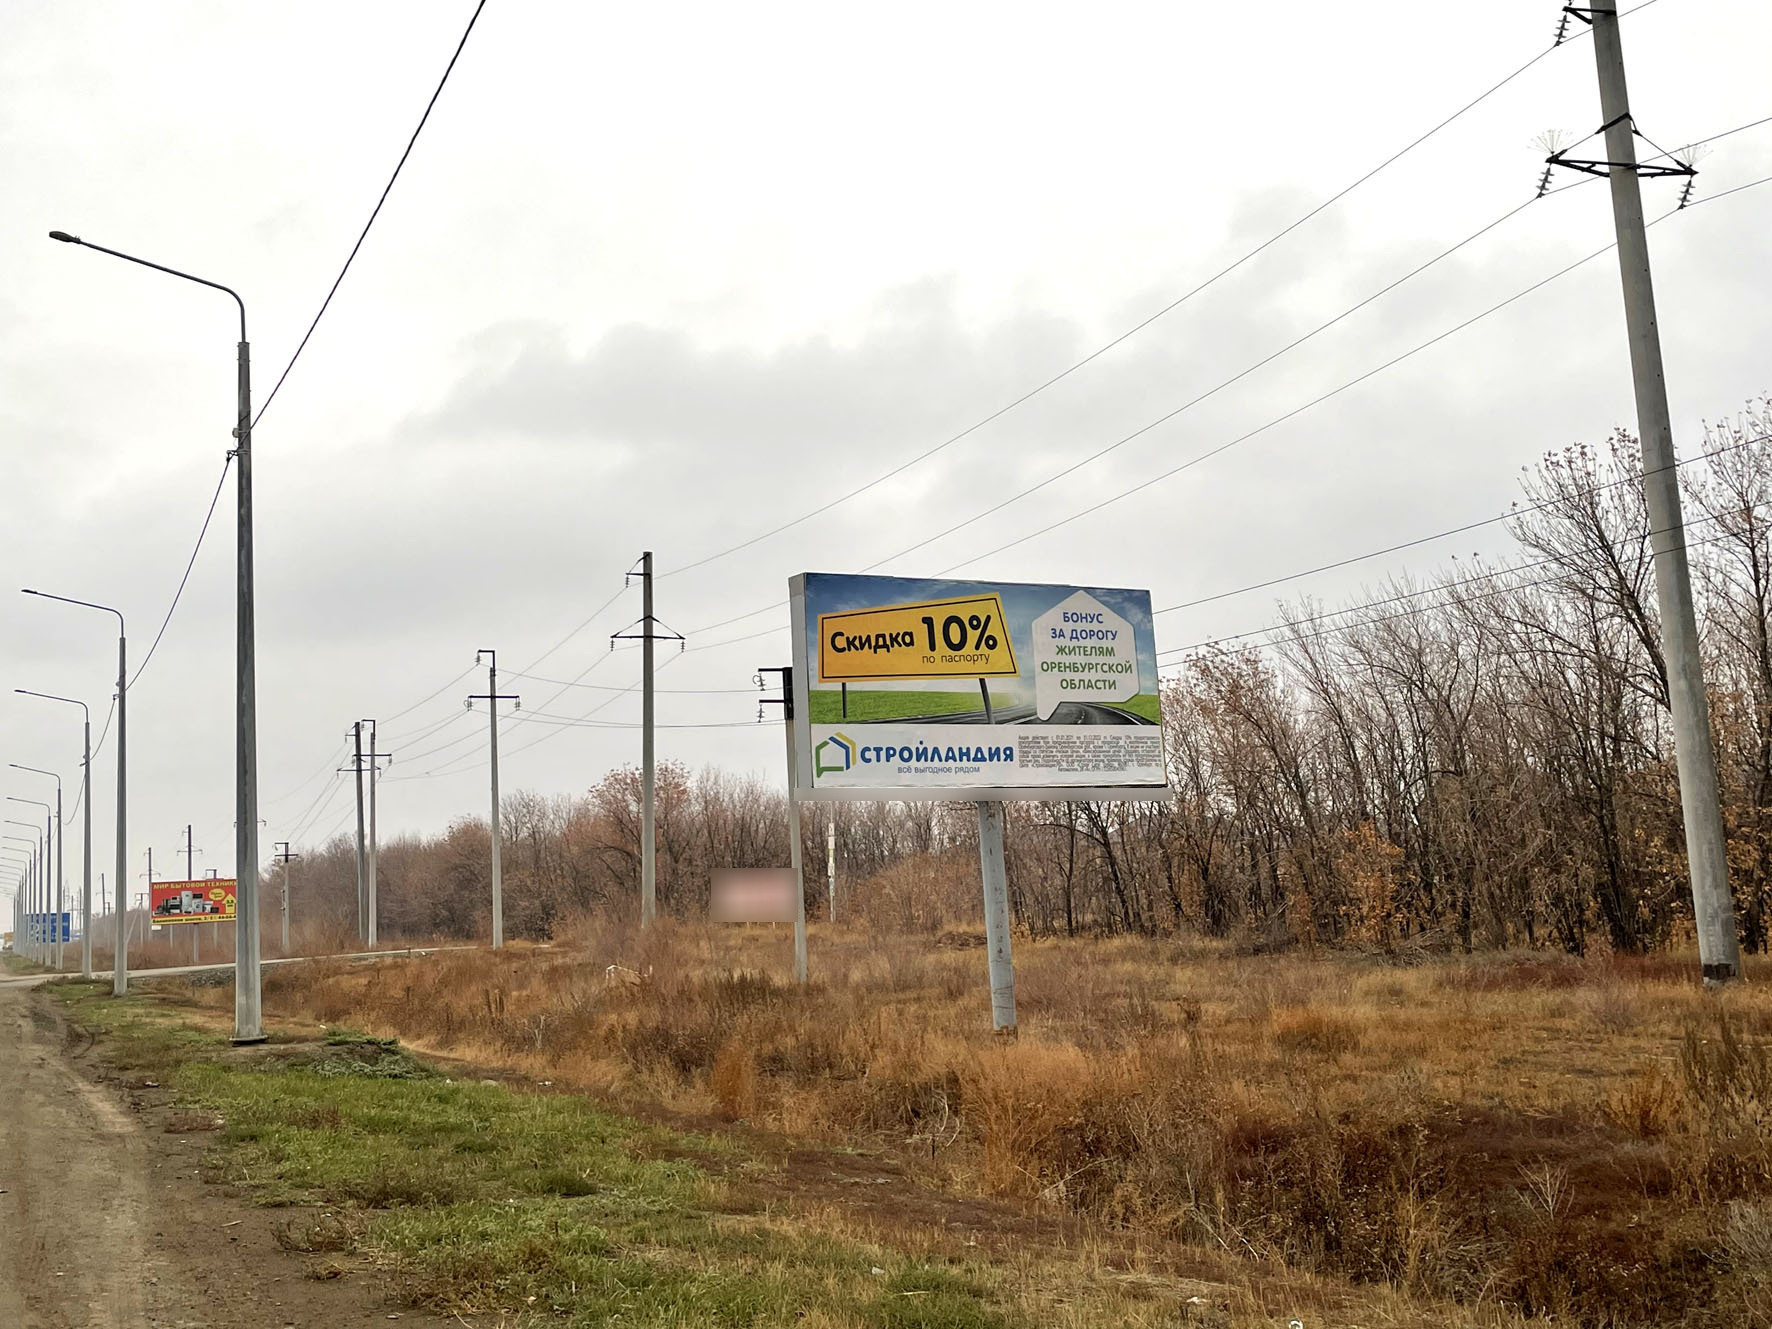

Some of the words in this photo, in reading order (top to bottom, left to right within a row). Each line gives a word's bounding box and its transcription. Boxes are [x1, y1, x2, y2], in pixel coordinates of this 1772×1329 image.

[1063, 612, 1104, 624] БОНУС
[830, 631, 915, 655] Скидка
[921, 614, 998, 653] 10%
[1050, 628, 1066, 639] ЗА
[1069, 628, 1118, 642] ДОРОГУ
[1055, 645, 1116, 657] ЖИТЕЛЯМ
[921, 655, 935, 664] по
[941, 653, 991, 665] паспорту
[1040, 660, 1133, 674] ОРЕНБУРГСКОЙ
[1060, 678, 1117, 690] ОБЛАСТИ
[860, 740, 1014, 763] СТРОЙЛАНДИЯ
[897, 766, 912, 774] всё
[914, 766, 953, 775] выгодное
[954, 766, 981, 775] рядом
[170, 881, 206, 889] БЫТОВОЙ
